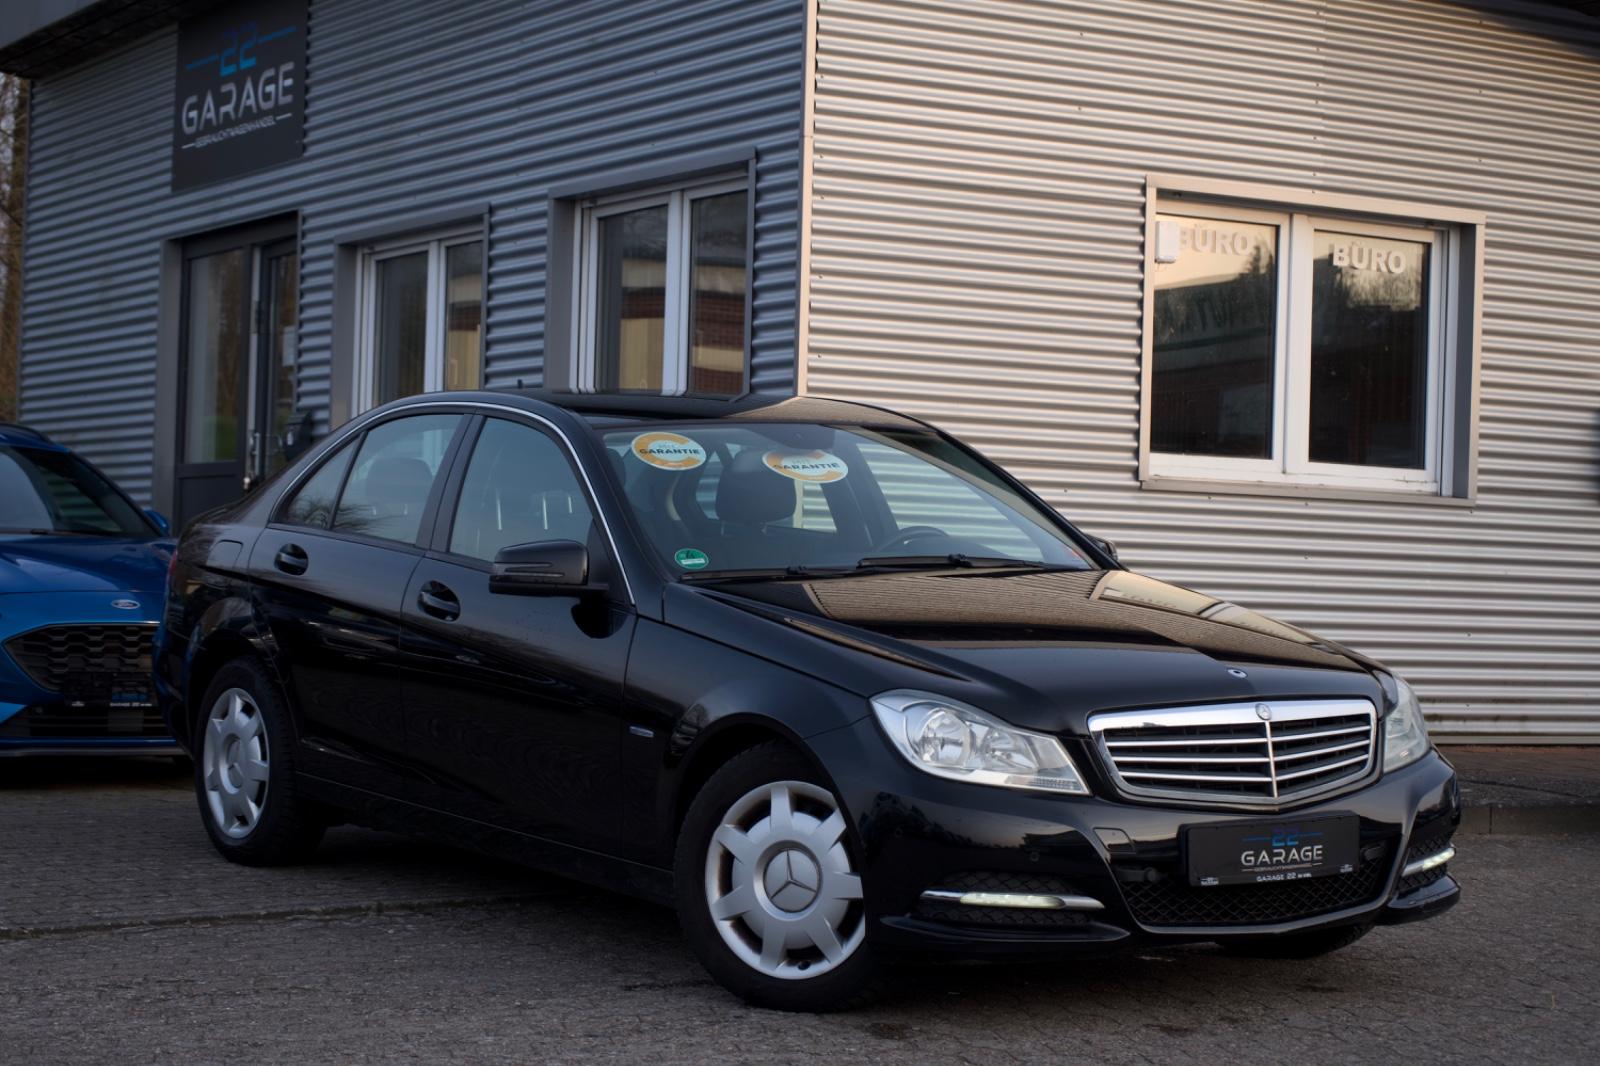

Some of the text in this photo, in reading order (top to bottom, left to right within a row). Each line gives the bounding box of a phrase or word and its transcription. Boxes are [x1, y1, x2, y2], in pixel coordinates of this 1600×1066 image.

[220, 22, 257, 77] 22
[182, 61, 295, 135] GARAGE
[1333, 241, 1406, 274] BÜRO
[1272, 827, 1299, 847] 22
[1241, 845, 1323, 866] GARAGE
[1256, 874, 1284, 882] GARAGE
[1287, 872, 1297, 880] 22
